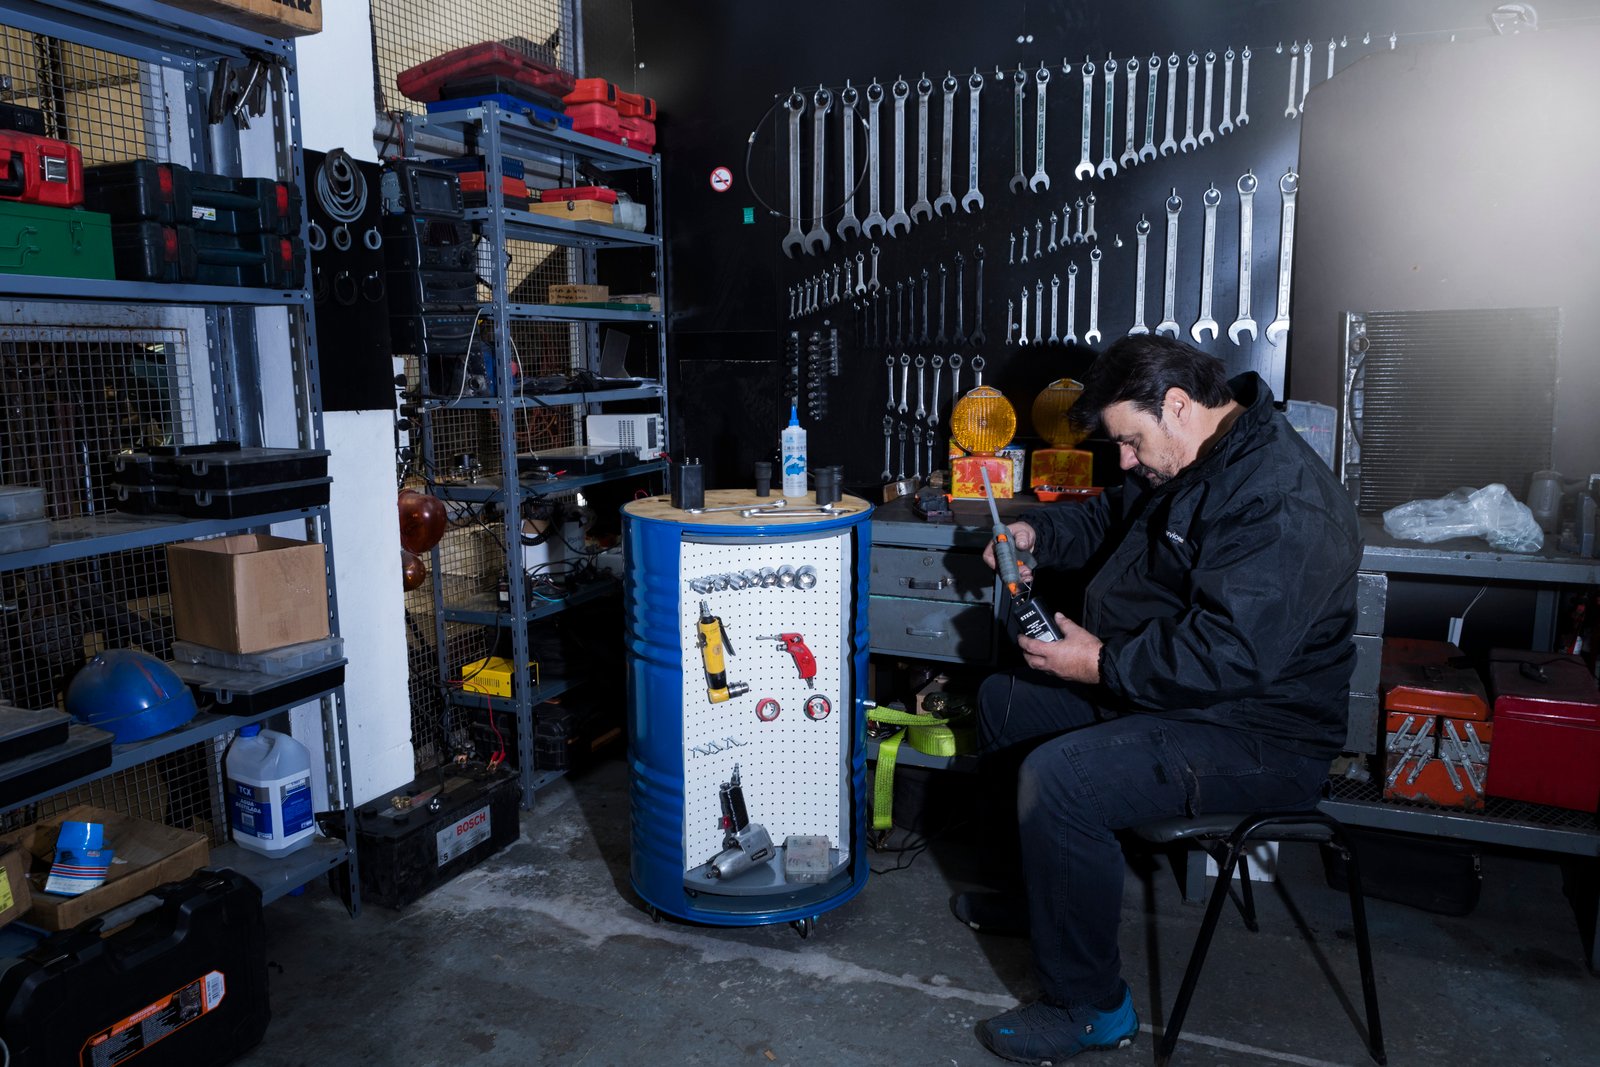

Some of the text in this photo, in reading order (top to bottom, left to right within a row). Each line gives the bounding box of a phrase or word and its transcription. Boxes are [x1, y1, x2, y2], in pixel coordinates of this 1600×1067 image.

[1020, 610, 1037, 622] STEEL
[238, 785, 252, 797] TCX
[456, 812, 486, 837] BOSCH
